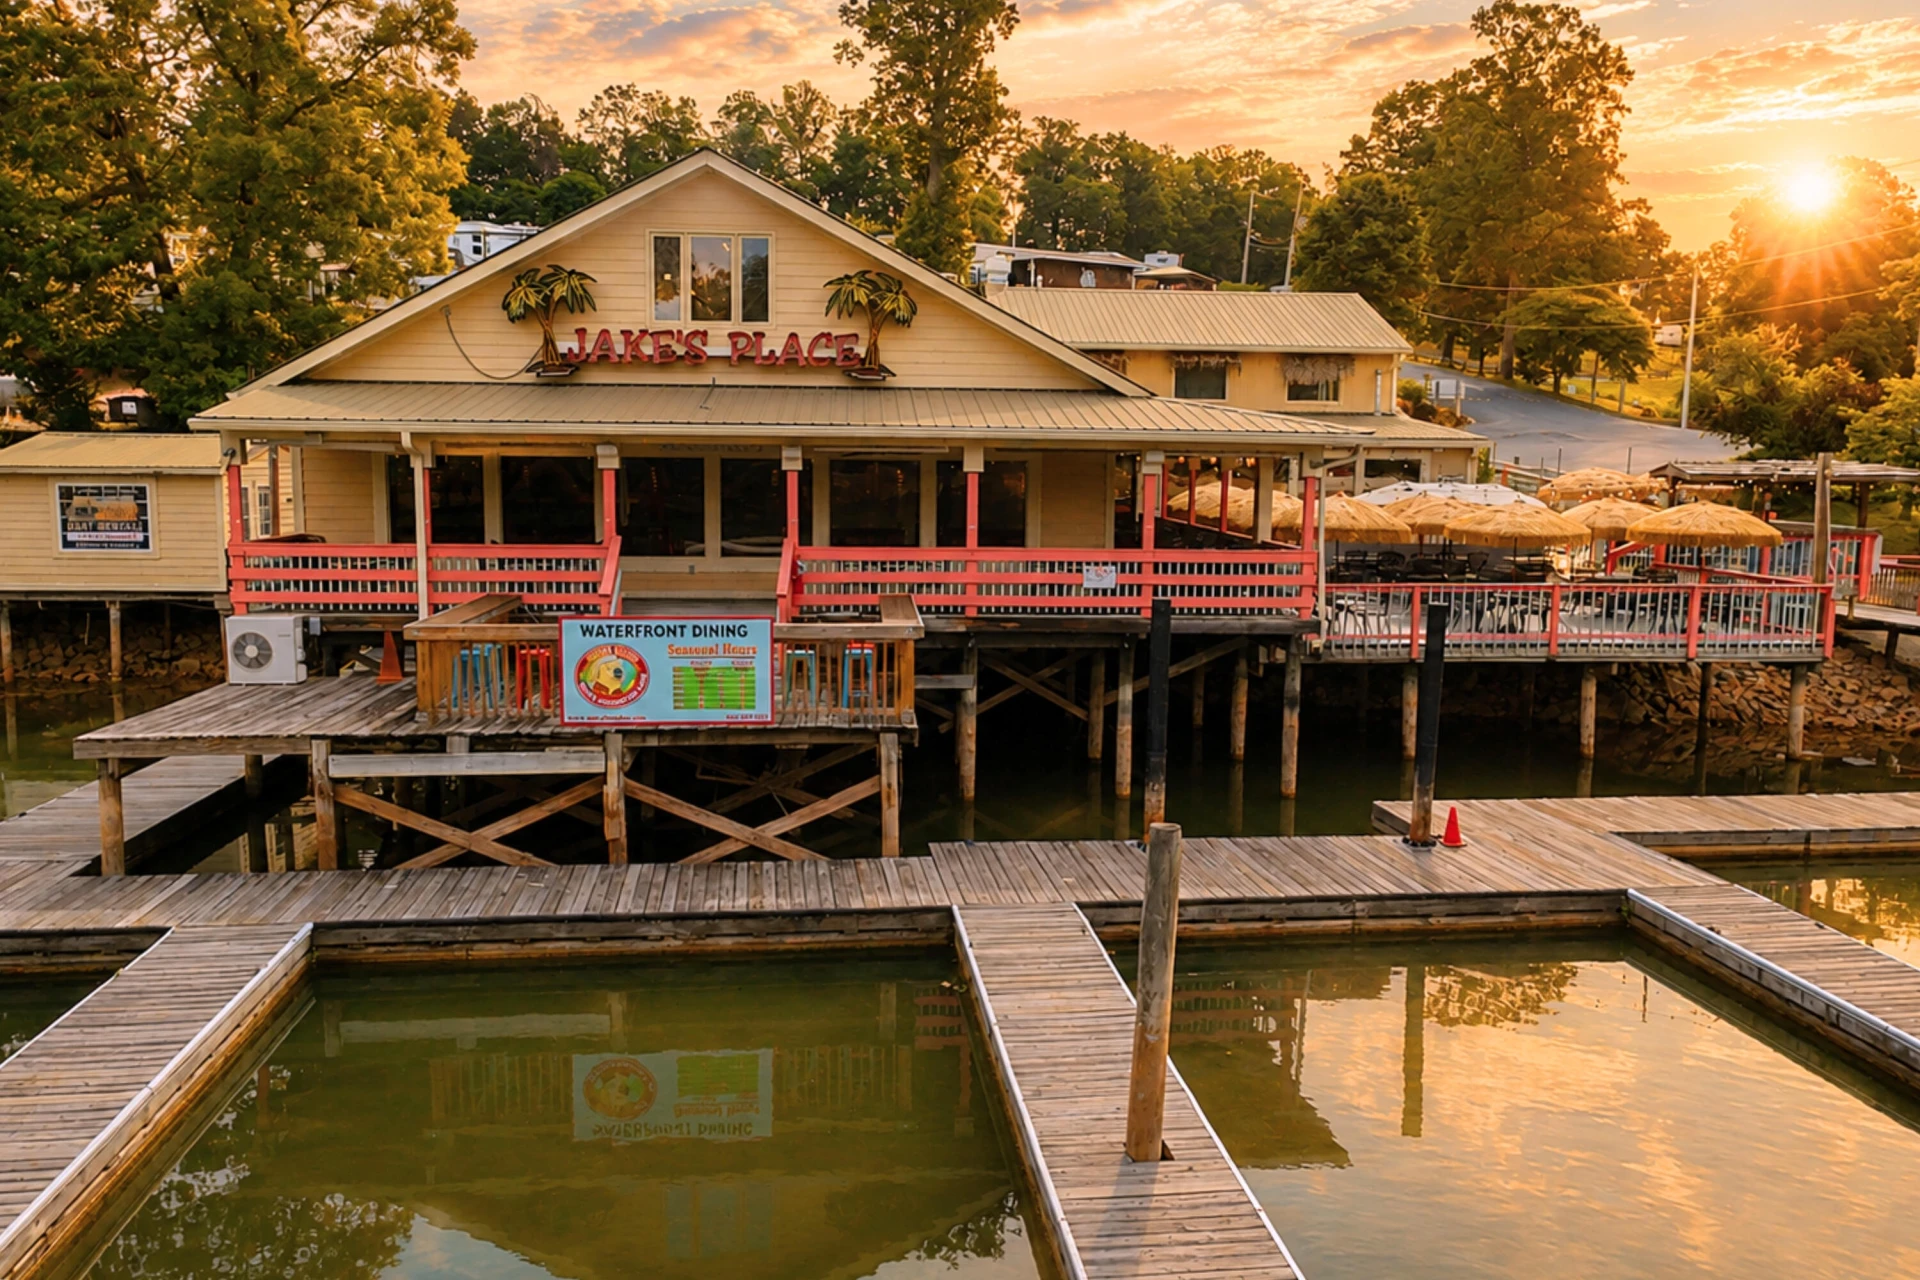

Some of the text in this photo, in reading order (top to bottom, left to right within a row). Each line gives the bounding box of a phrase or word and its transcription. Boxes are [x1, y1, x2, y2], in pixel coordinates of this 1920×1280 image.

[567, 327, 861, 367] JAKE'S PLACE
[580, 624, 748, 638] WATERFRONT DINING
